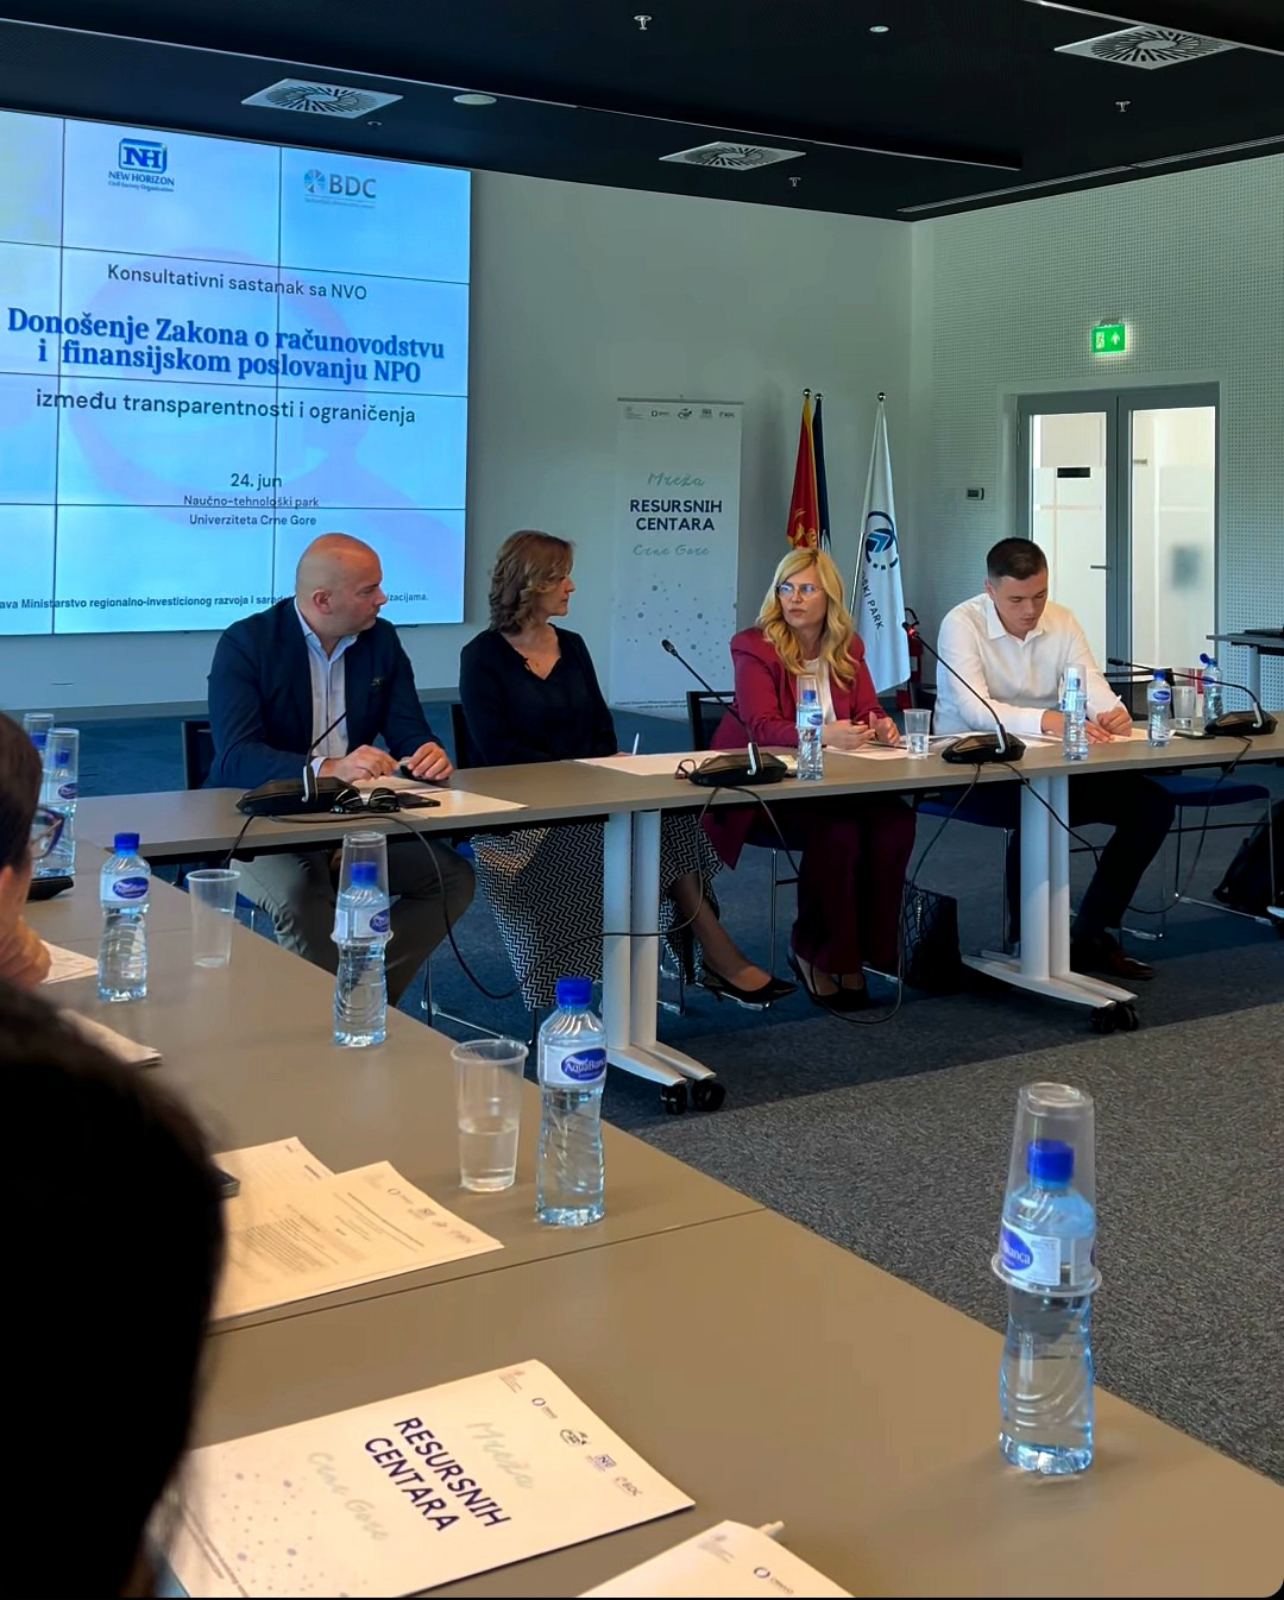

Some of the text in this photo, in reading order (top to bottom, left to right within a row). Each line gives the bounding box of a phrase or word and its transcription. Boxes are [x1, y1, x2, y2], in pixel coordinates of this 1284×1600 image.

[123, 146, 162, 169] NH
[108, 170, 175, 186] NEW HORIZON
[329, 173, 376, 199] BDC
[107, 263, 367, 300] Konsultativni sastanak sa NVO
[7, 307, 445, 359] Donošenje Zakona o računovodstvu
[38, 338, 421, 385] i finansijskom poslovanju NPO
[36, 388, 416, 427] između transparentnosti i ograničenja
[230, 472, 282, 491] 24. jun
[183, 495, 319, 509] Naučno-tehnološki park
[630, 499, 722, 513] RESURSNIH
[189, 514, 317, 525] Univerziteta Crne Gore
[636, 517, 715, 531] CENTARA
[21, 598, 87, 609] Ministarstvo
[89, 596, 212, 610] regionalno-investicionog
[214, 596, 248, 606] razvoja
[867, 599, 884, 630] PARK
[393, 1416, 511, 1527] RESURSNIH
[364, 1437, 460, 1531] CENTARA
